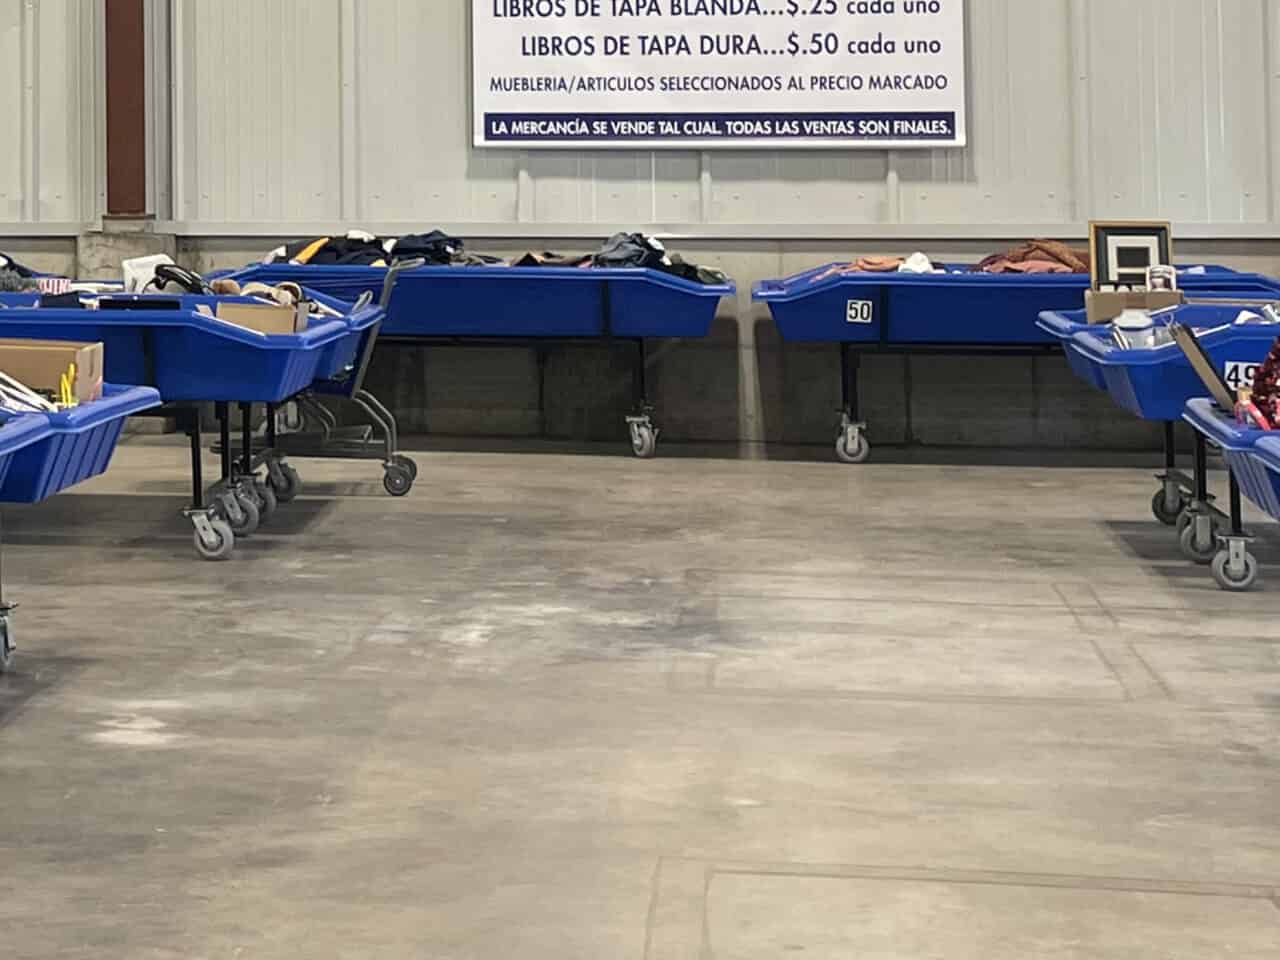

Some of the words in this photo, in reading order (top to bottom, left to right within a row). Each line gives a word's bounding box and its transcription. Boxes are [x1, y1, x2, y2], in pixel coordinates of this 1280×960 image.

[904, 0, 940, 13] uno
[522, 36, 595, 56] LIBROS
[604, 36, 629, 55] DE
[638, 35, 691, 55] TAPA
[848, 32, 895, 54] cada
[904, 40, 941, 53] uno
[660, 76, 782, 91] SELECCIONADOS
[788, 76, 805, 90] AL
[811, 76, 863, 90] PRECIO
[869, 75, 947, 90] MARCADO
[492, 122, 508, 134] LA
[512, 119, 589, 134] MERCANCÍA
[593, 122, 607, 134] SE
[611, 122, 654, 134] VENDE
[659, 122, 680, 134] TAL
[726, 121, 771, 134] TODAS
[776, 121, 799, 134] LAS
[803, 121, 855, 134] VENTAS
[859, 121, 889, 134] SON
[894, 120, 951, 134] FINALES.
[849, 302, 870, 321] 50
